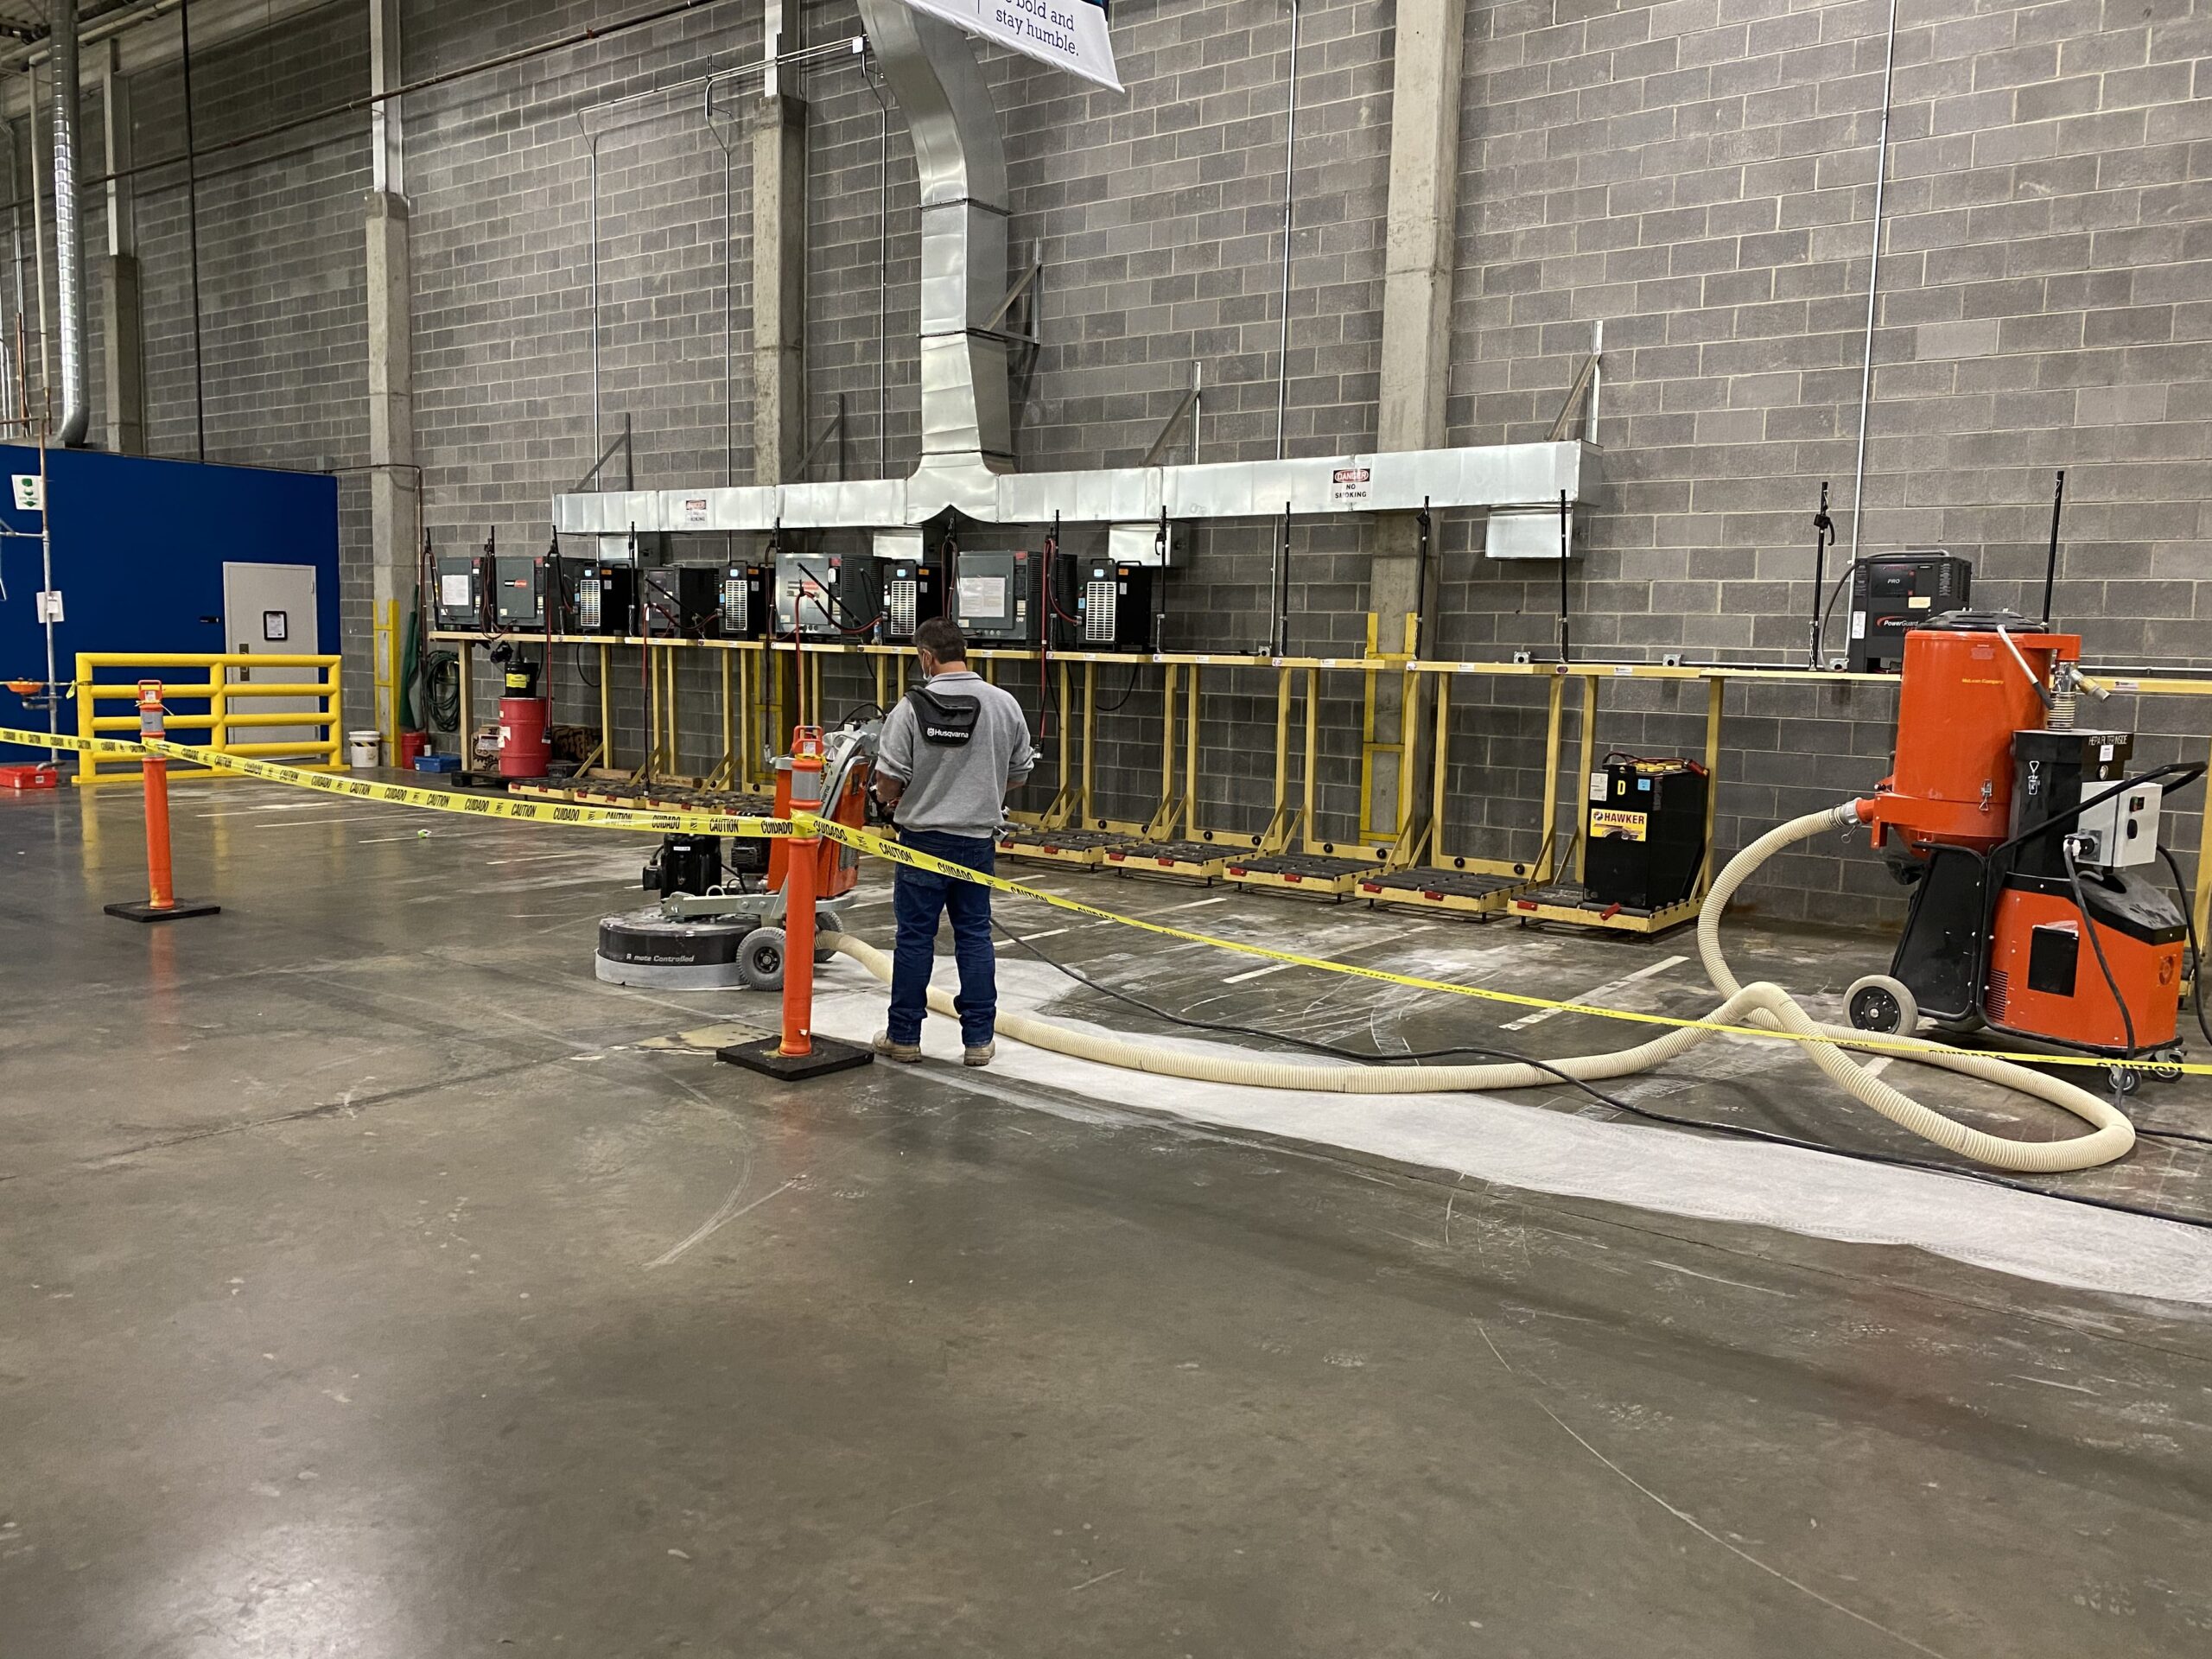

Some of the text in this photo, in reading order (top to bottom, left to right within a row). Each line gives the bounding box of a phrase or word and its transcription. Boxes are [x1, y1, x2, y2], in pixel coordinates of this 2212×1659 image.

[1016, 0, 1074, 31] bold and
[996, 10, 1079, 56] stay humble.
[935, 729, 969, 738] Husqvarna
[1618, 780, 1626, 795] D
[311, 776, 332, 788] CUIDADO
[349, 783, 372, 795] CAUTION
[385, 788, 407, 801] CUIDADO
[427, 794, 450, 807] CAUTION
[465, 798, 489, 812] CUIDADO
[512, 804, 537, 817] CAUTION
[553, 808, 580, 821] CUIDADO
[652, 815, 680, 830] CUIDADO
[709, 818, 739, 833] CAUTION
[760, 820, 793, 835] CUIDADO
[1605, 812, 1644, 824] HAWKER
[814, 821, 848, 841] CUIDADO
[879, 842, 915, 863] CAUTION
